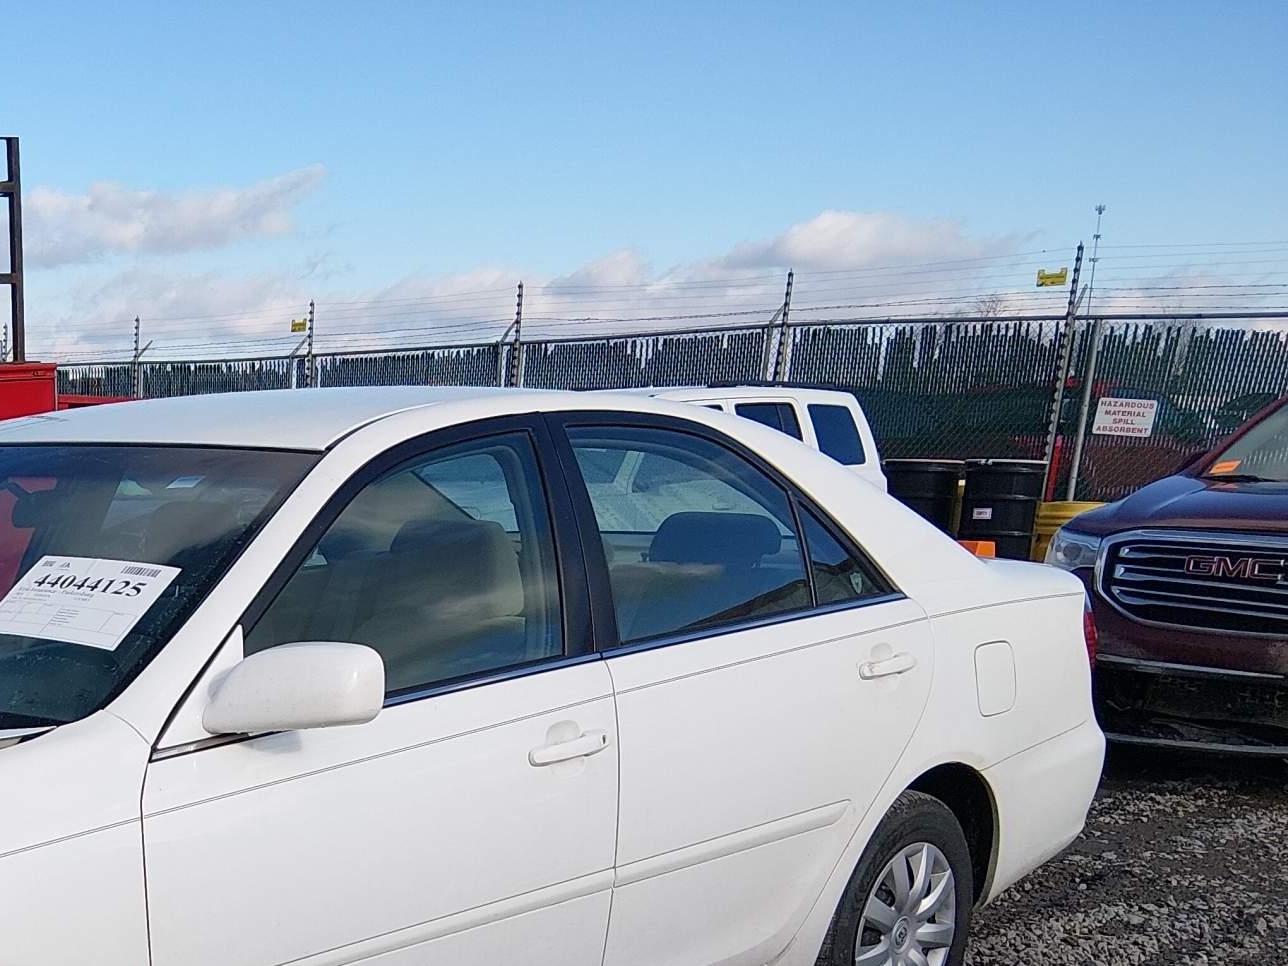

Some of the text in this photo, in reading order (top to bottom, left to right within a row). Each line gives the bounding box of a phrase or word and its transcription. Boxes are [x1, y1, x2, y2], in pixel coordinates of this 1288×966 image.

[1101, 400, 1154, 410] HAZARDOUS
[1104, 409, 1146, 418] MATERIAL
[1112, 418, 1135, 426] SPILL
[1096, 425, 1149, 434] ABSORBENT
[1184, 554, 1284, 580] GMC
[34, 572, 147, 598] 44044125
